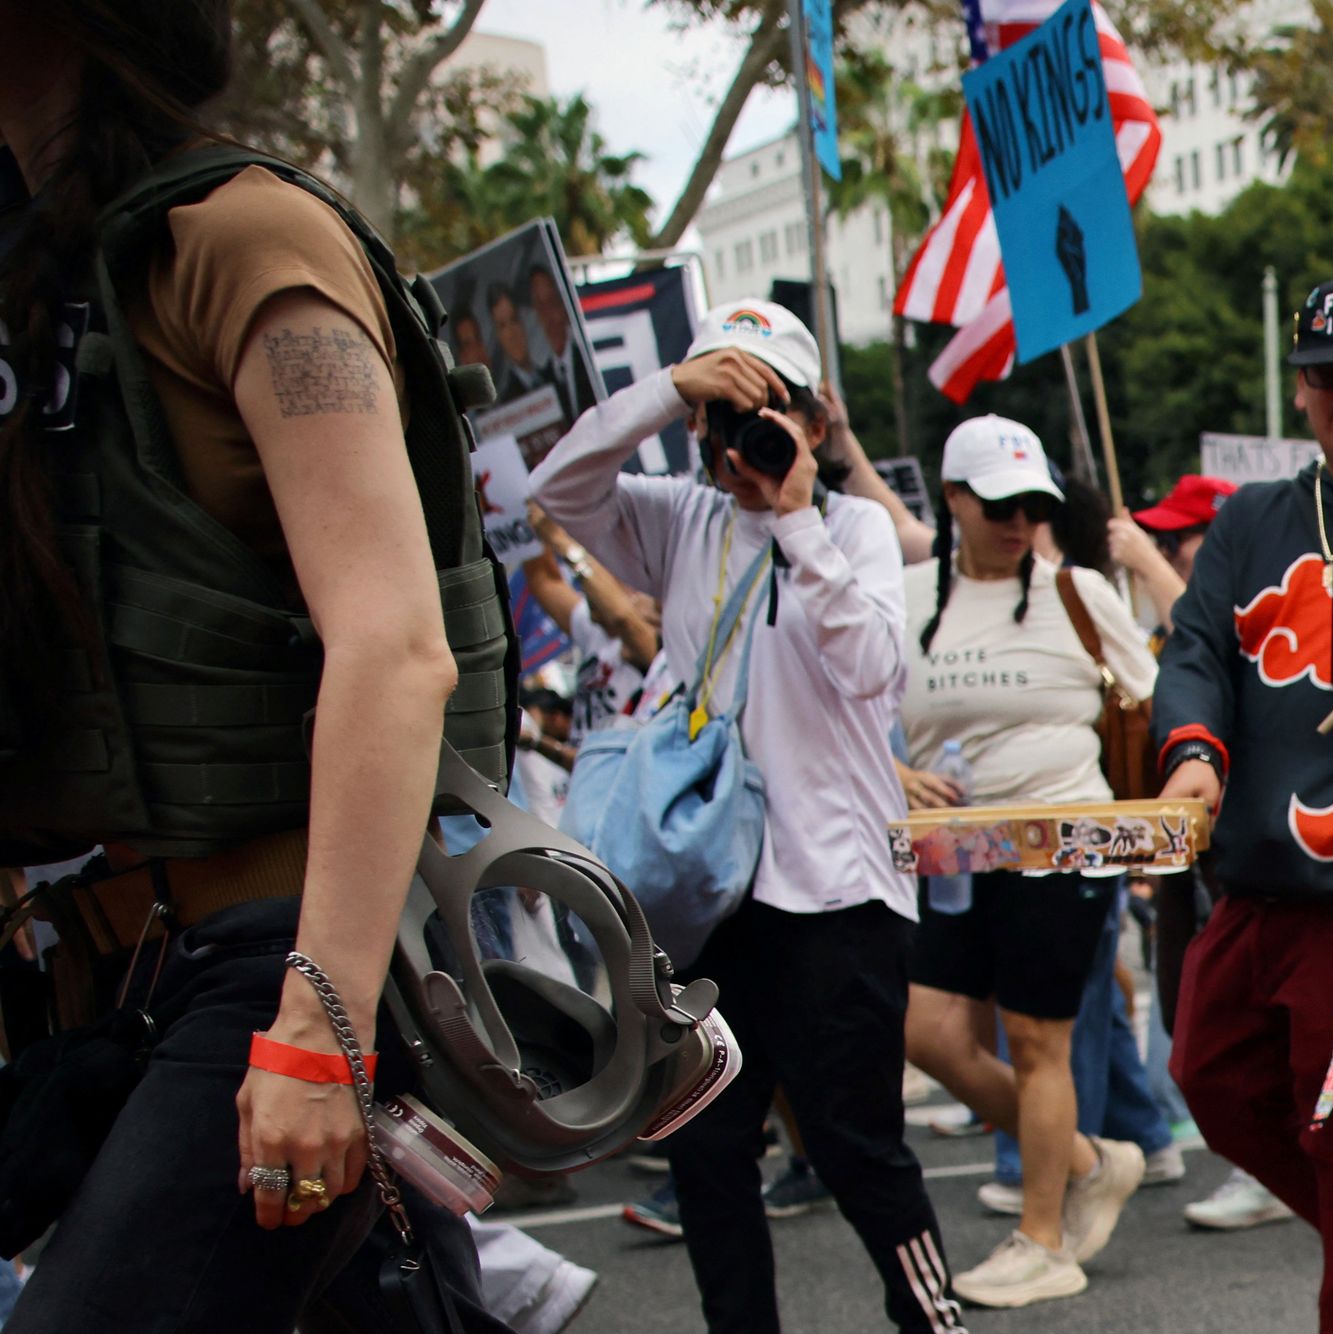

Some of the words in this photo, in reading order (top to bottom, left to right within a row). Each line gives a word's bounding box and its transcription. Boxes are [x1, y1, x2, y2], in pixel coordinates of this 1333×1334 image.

[973, 76, 1023, 207] NO
[1010, 6, 1106, 174] KINGS
[927, 648, 988, 667] VOTE
[926, 670, 1030, 693] BITCHES
